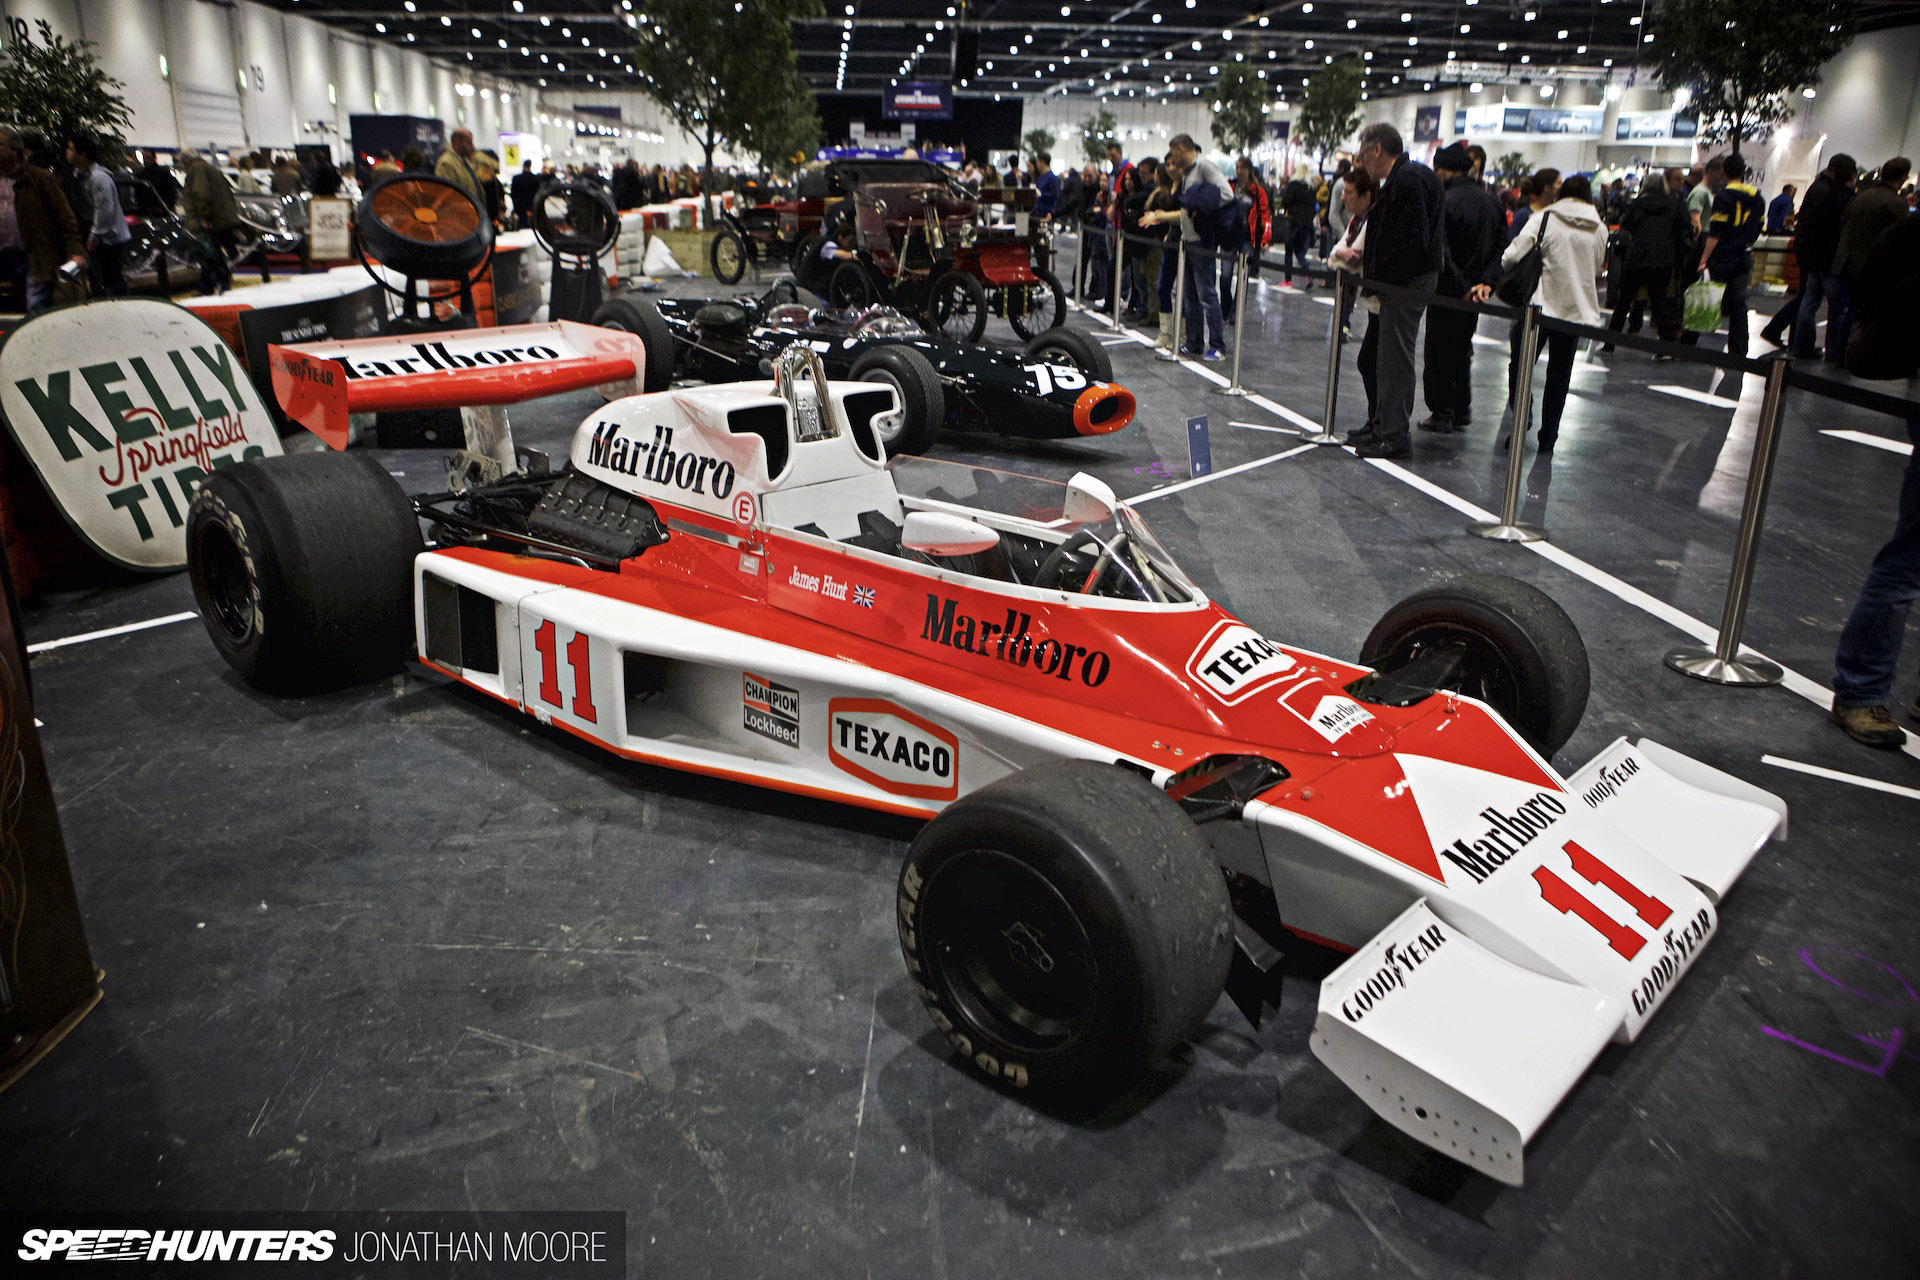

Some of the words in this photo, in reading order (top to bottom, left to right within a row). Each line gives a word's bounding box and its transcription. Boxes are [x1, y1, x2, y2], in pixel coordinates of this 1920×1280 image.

[14, 344, 248, 462] KELLY
[99, 407, 249, 486] Springfield
[587, 421, 735, 499] Marlboro
[106, 445, 266, 541] TIR
[738, 499, 750, 521] E
[788, 565, 820, 593] James
[821, 574, 848, 601] Hunt
[534, 617, 598, 725] 11
[920, 593, 1110, 687] Marlboro
[1203, 638, 1284, 686] TEXA
[744, 711, 798, 743] Lockheed
[745, 681, 797, 714] CHAMPION
[836, 717, 950, 777] TEXACO
[1582, 757, 1640, 809] OODYEAR
[1441, 792, 1567, 884] Marlboro
[1531, 839, 1674, 962] 11
[1342, 924, 1447, 1023] GOODYEAR
[1631, 908, 1711, 1017] GOODYEAR
